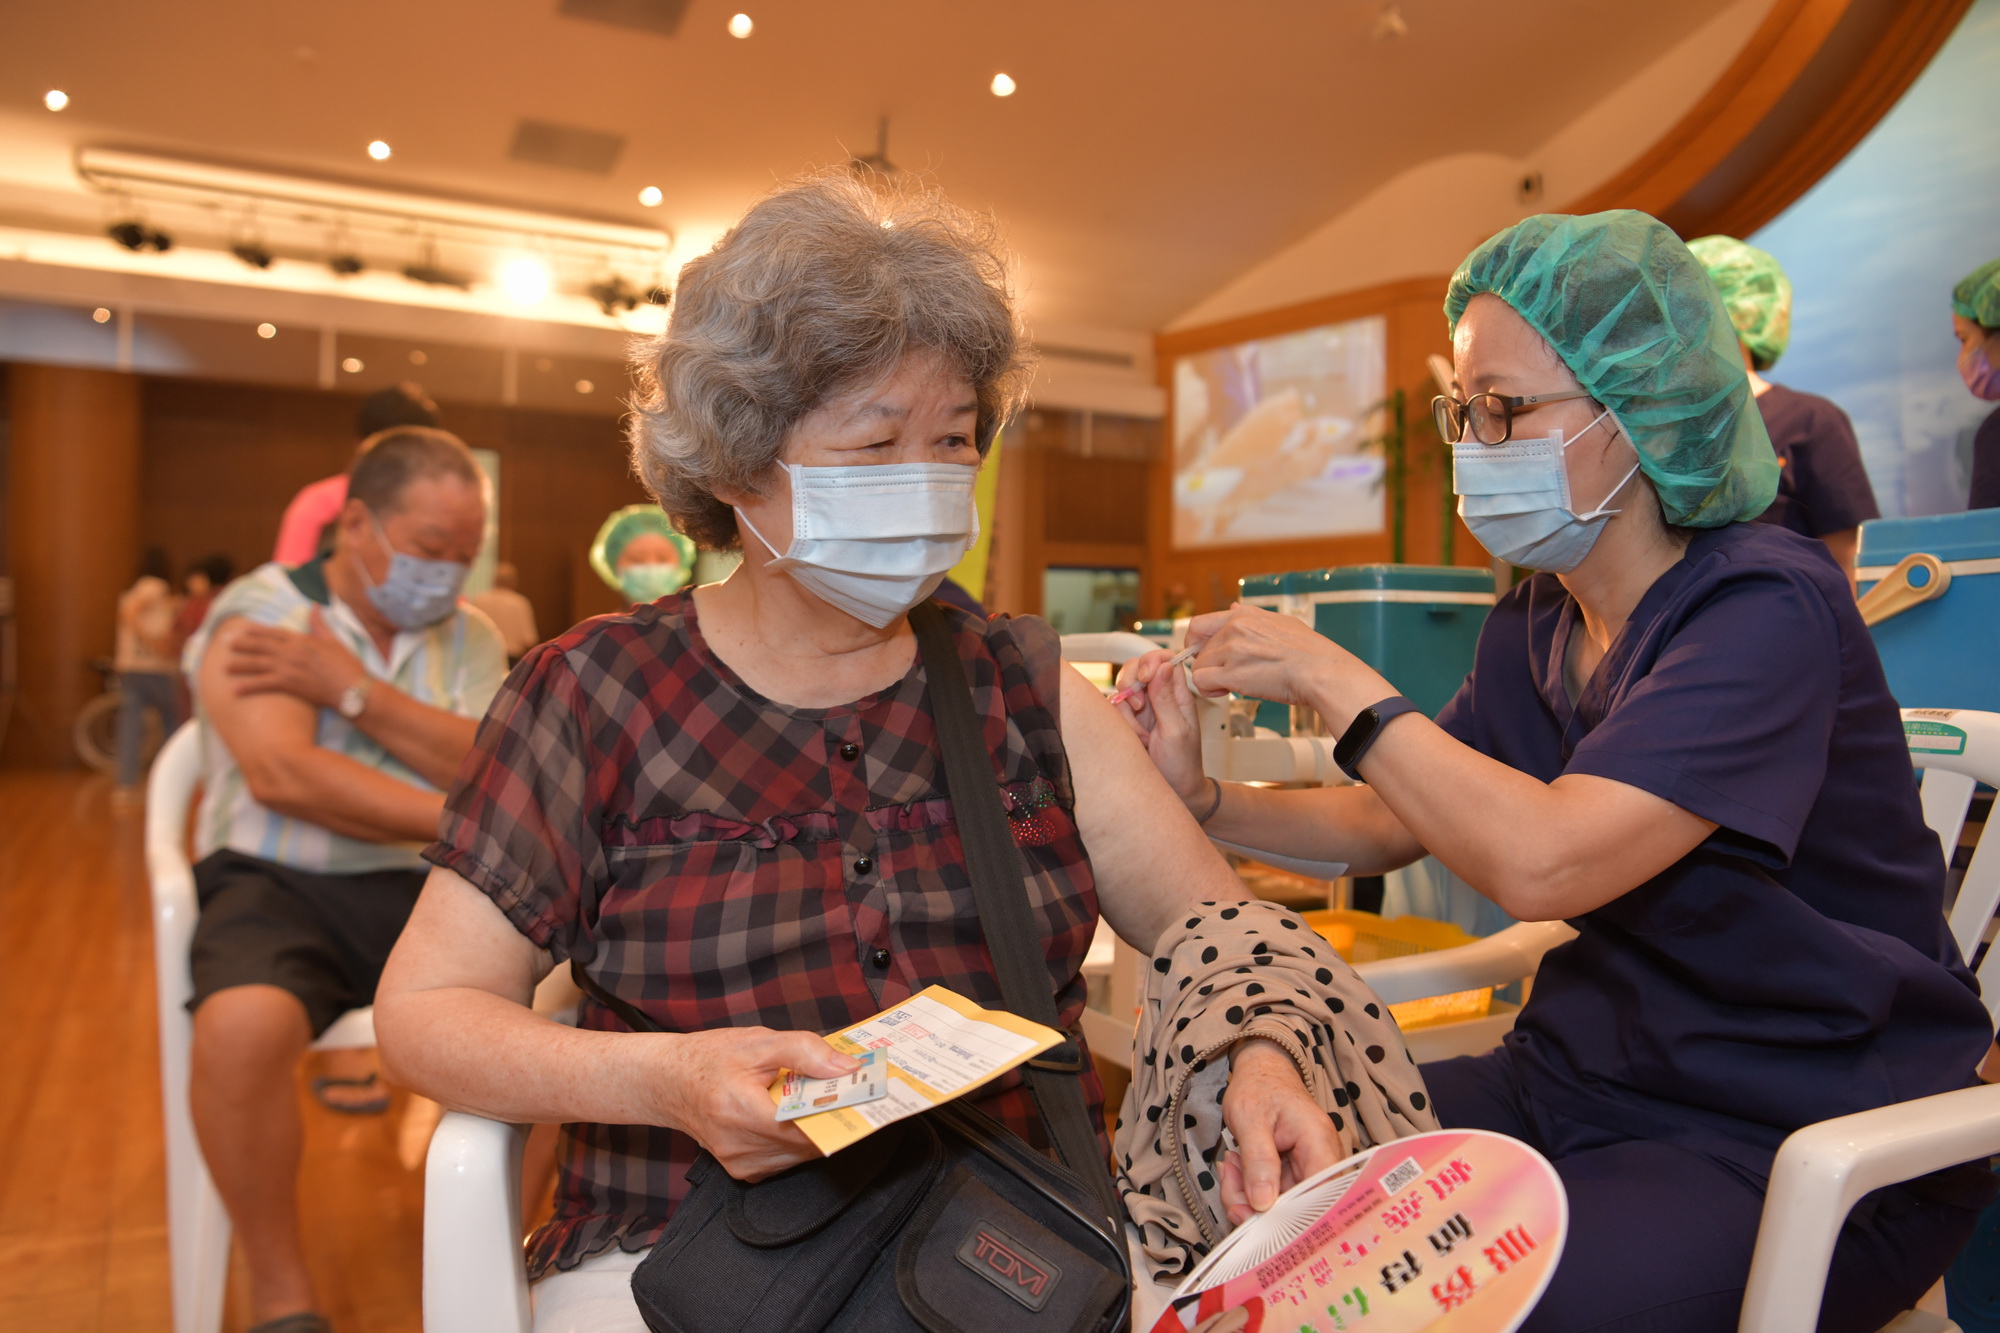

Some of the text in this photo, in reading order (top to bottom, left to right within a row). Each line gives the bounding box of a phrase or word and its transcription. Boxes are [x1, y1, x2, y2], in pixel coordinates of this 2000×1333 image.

[1296, 1211, 1476, 1333] 值得信
[1429, 1223, 1540, 1314] 服務
